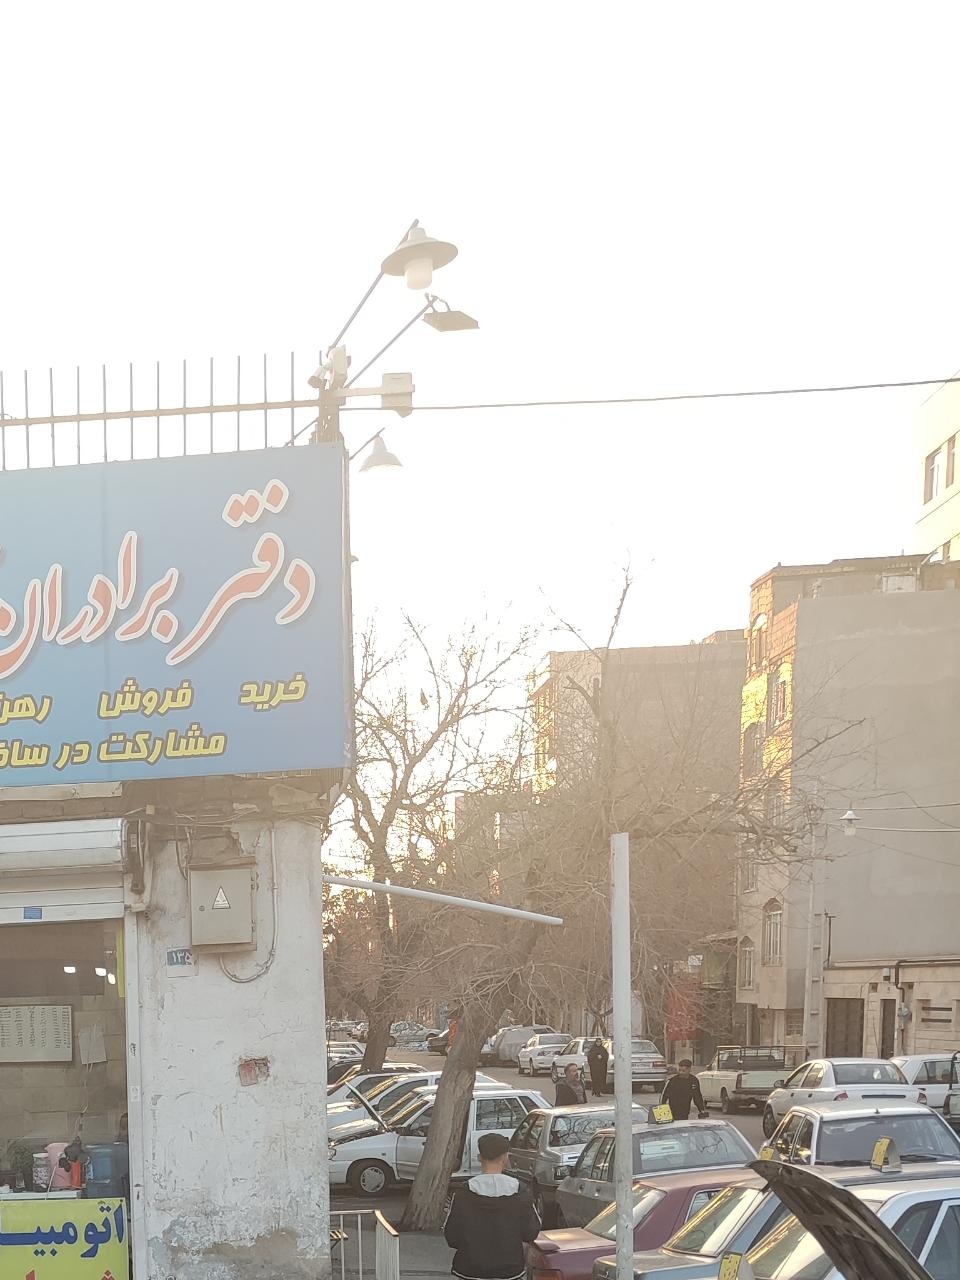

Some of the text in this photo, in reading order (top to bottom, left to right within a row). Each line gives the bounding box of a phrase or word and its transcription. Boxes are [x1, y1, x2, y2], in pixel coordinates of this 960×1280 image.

[166, 478, 317, 666] دفتر
[97, 676, 194, 720] فروش
[237, 672, 308, 711] خرید
[54, 738, 93, 771] در
[97, 721, 227, 765] مشارکت
